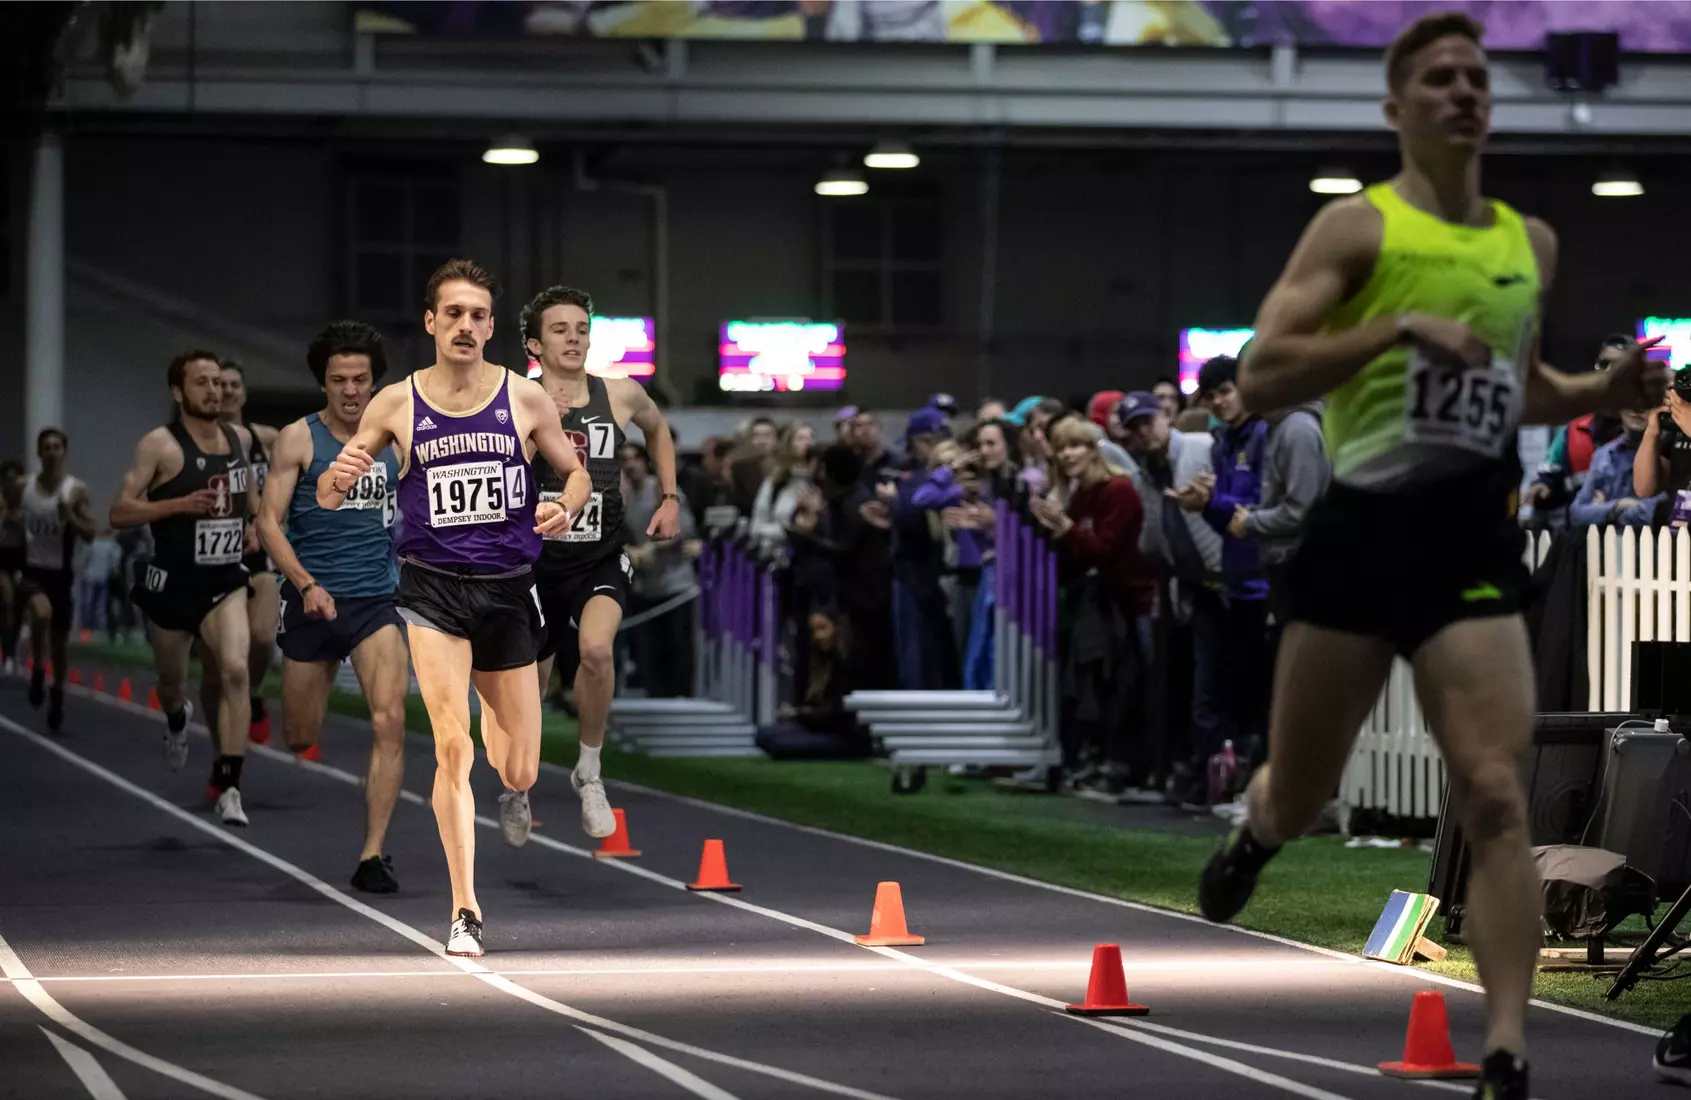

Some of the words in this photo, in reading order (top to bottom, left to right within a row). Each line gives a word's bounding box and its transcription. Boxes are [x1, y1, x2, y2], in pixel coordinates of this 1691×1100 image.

[1410, 368, 1511, 434] 1255
[414, 432, 516, 465] WASHINGTON
[594, 425, 609, 456] 7
[233, 470, 248, 491] 10
[432, 465, 498, 480] WASHINGTON
[512, 468, 524, 505] 4
[345, 474, 386, 501] 896
[432, 476, 503, 516] 1975
[387, 493, 395, 525] 5
[437, 515, 472, 525] DEMPSEY
[473, 512, 501, 522] INDOOR
[571, 505, 600, 532] 24
[198, 530, 242, 555] 1722
